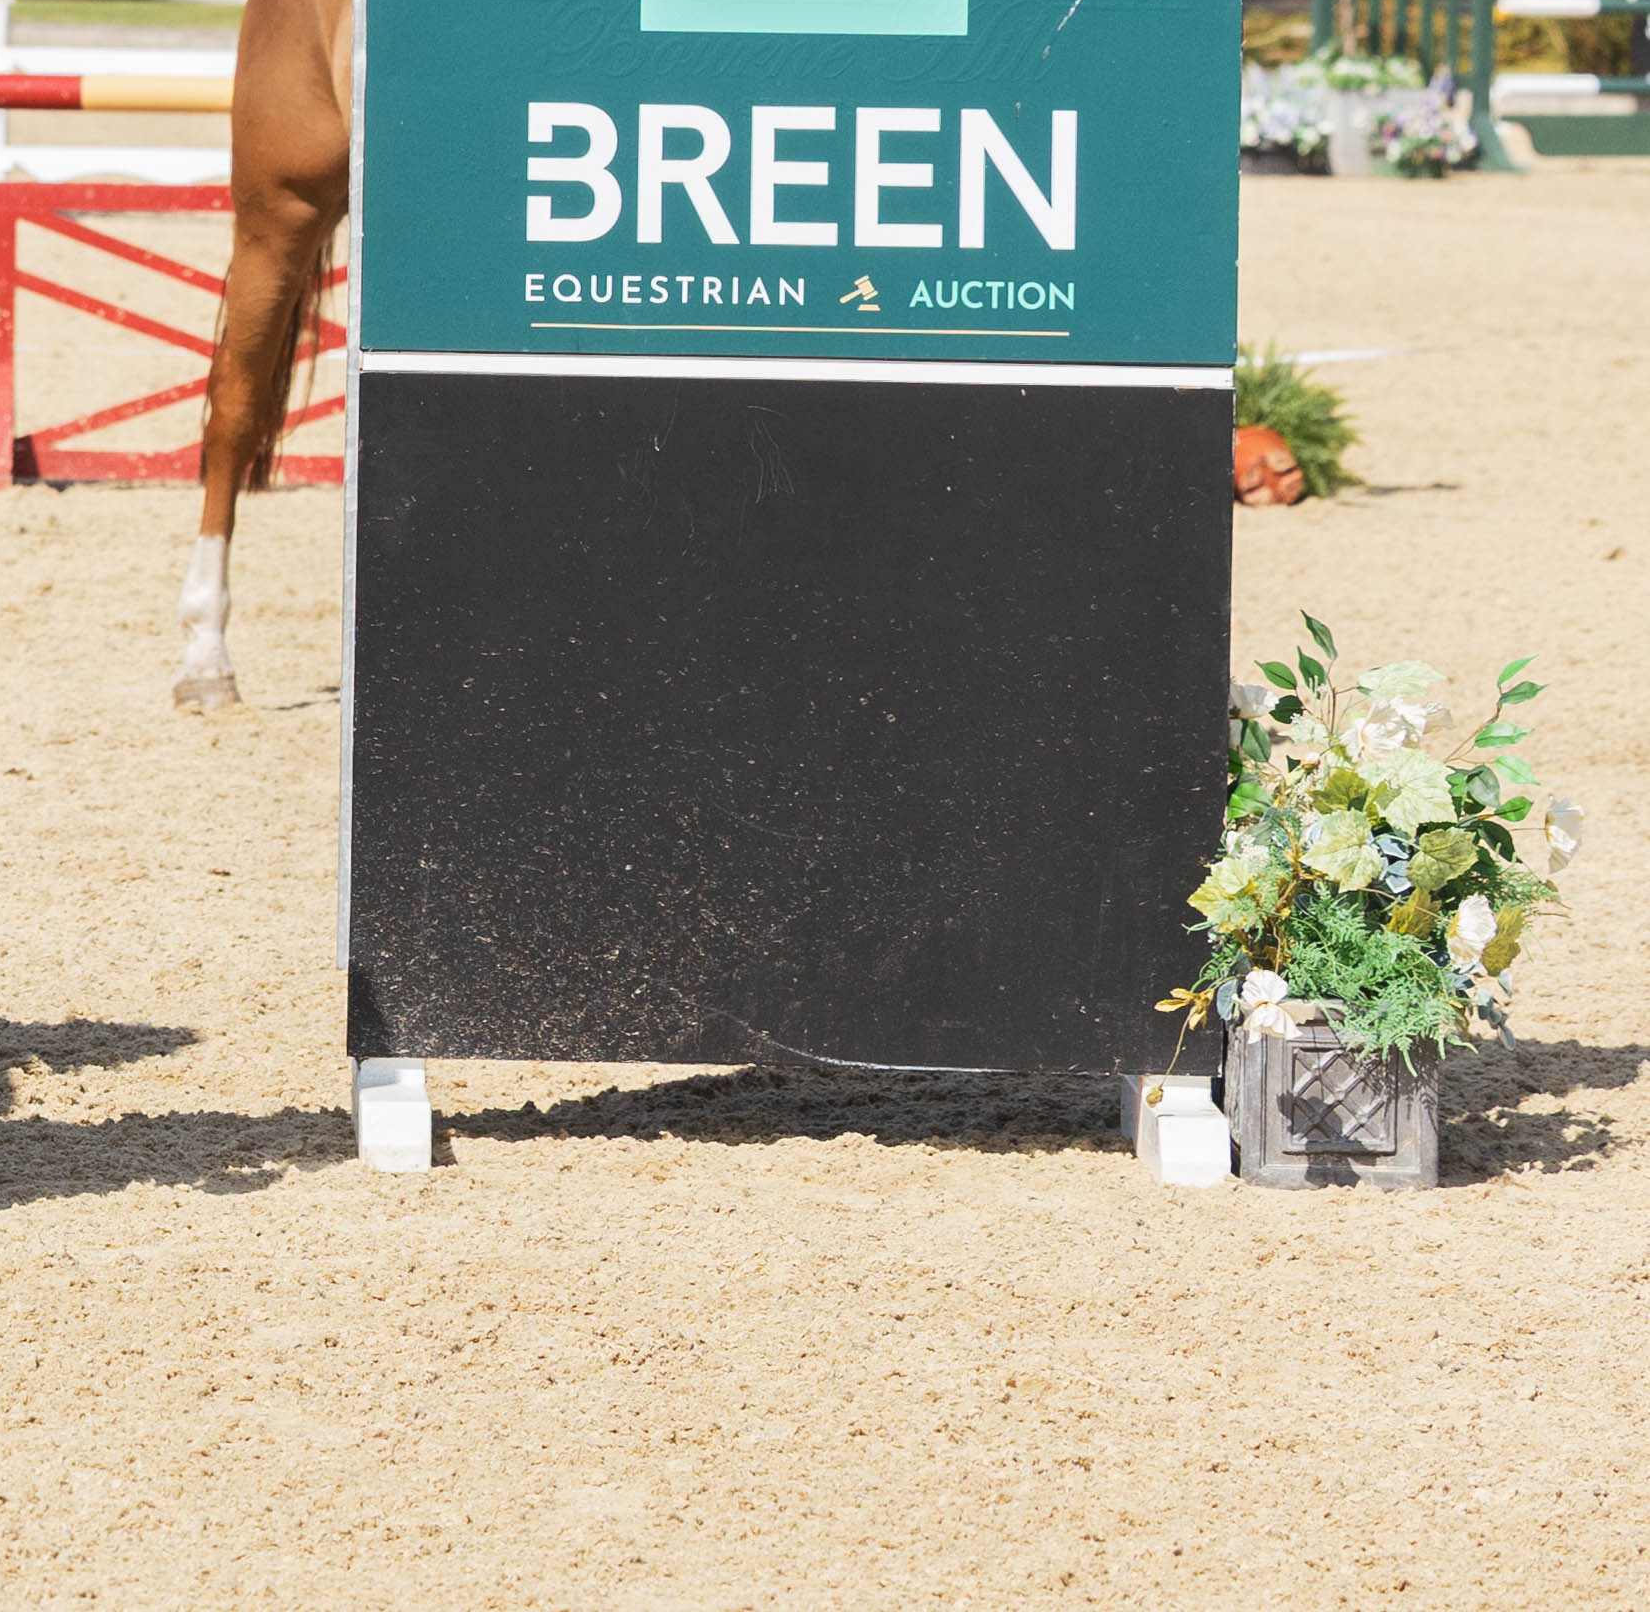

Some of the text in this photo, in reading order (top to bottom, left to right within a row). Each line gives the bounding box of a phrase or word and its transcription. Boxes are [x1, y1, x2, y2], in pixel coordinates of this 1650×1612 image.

[526, 102, 1078, 251] BREEN
[524, 273, 1075, 310] EQUESTRIAN AUCTION
